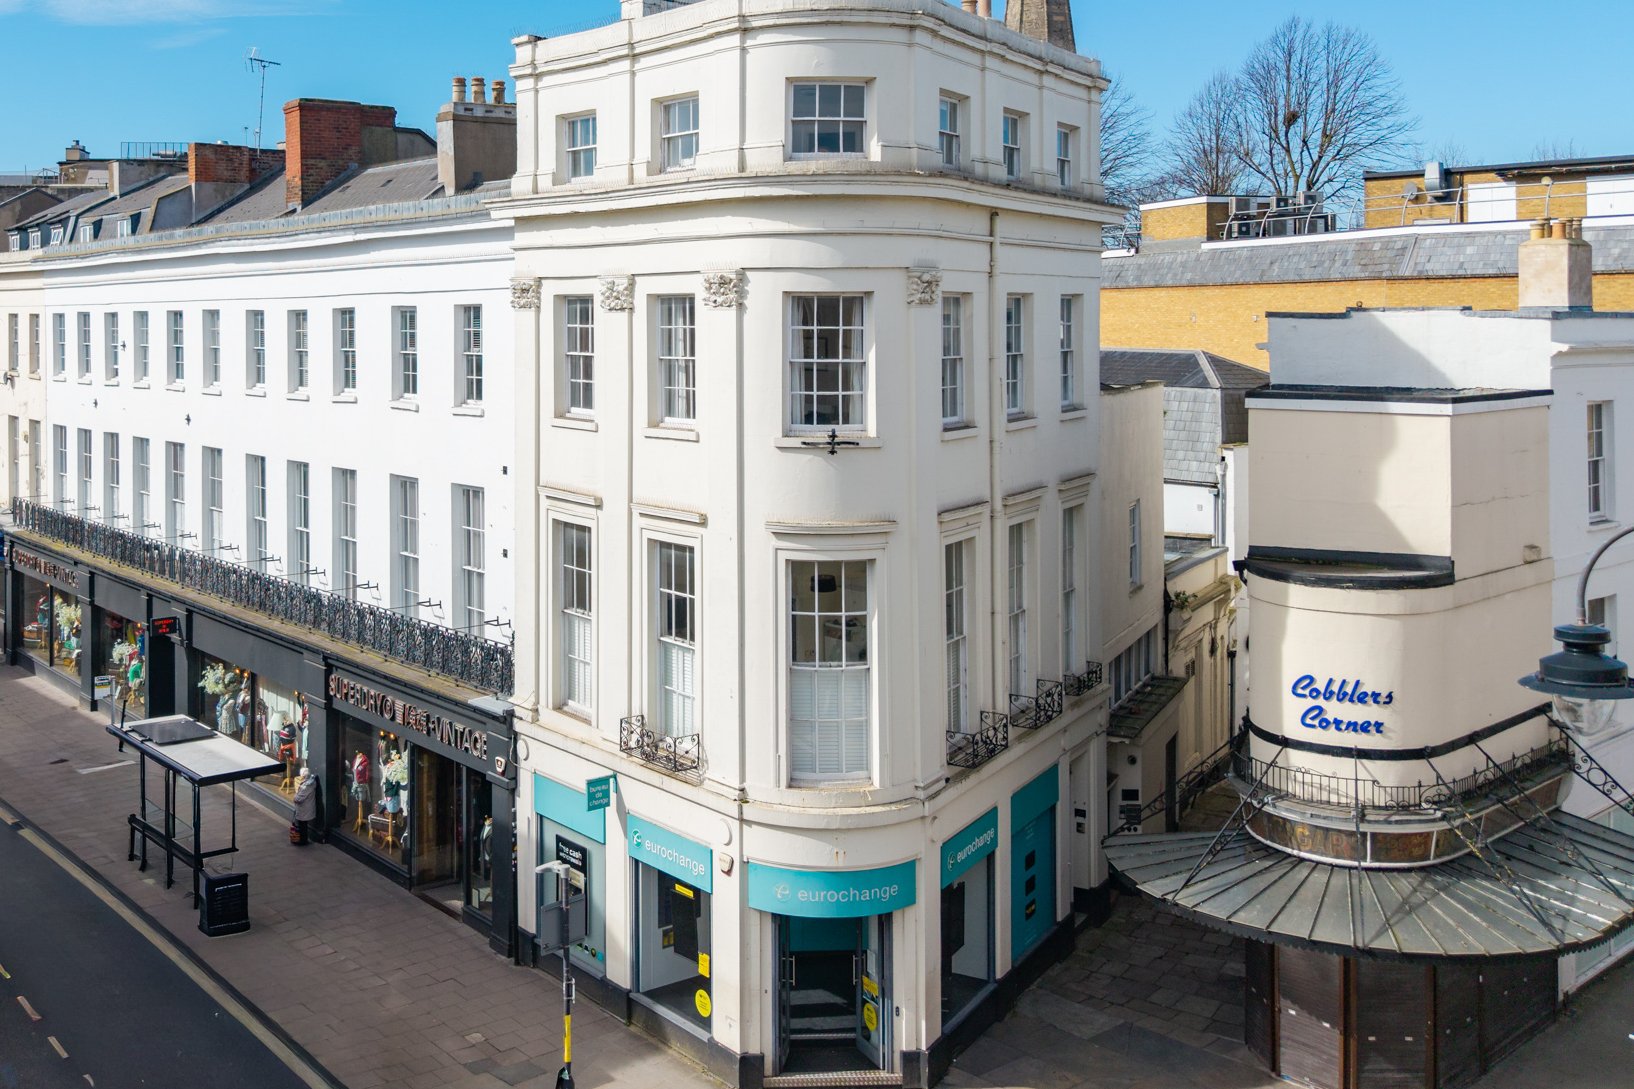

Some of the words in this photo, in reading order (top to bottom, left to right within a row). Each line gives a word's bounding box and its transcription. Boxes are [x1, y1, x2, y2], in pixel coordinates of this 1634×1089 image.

[1291, 674, 1394, 705] Cobblers
[1300, 705, 1384, 734] Corner
[589, 784, 609, 793] bureau
[595, 791, 602, 799] de
[589, 797, 609, 807] change
[569, 849, 582, 860] cash
[957, 827, 995, 863] eurochange
[645, 839, 705, 876] eurochange
[797, 884, 898, 903] eurochange
